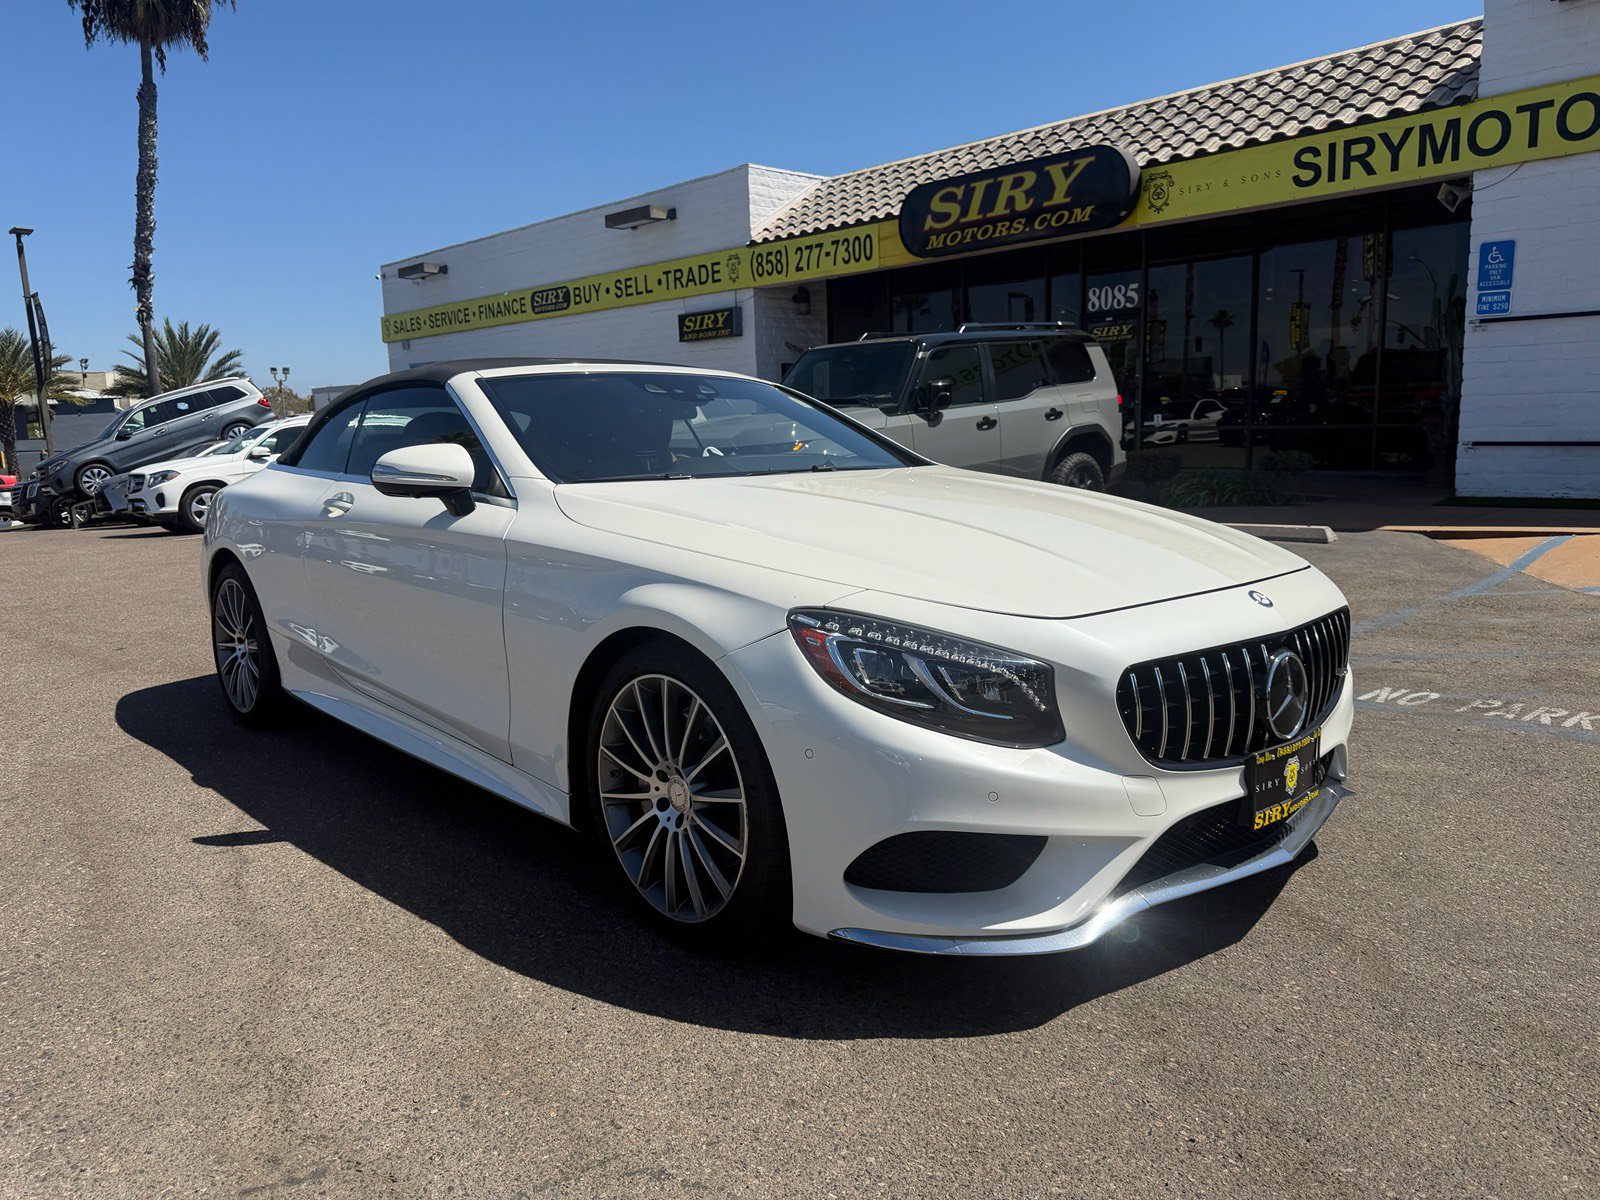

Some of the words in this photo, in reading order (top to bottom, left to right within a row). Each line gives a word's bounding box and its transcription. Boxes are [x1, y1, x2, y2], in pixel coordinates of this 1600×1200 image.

[1291, 91, 1600, 188] SIRYMOTO
[923, 155, 1097, 232] SIRY
[1178, 182, 1212, 196] SIRY
[1222, 179, 1230, 188] &
[1240, 169, 1282, 185] SONS
[925, 205, 1095, 250] MOTORS.COM
[750, 243, 789, 282] (858)
[794, 233, 874, 274] 277-7300
[1484, 262, 1508, 270] PARKING
[573, 282, 602, 305] BUY
[614, 275, 653, 298] SELL
[663, 261, 722, 290] TRADE
[1480, 279, 1510, 287] ACCESSIBLE
[534, 288, 568, 306] SIRY
[1087, 283, 1139, 312] 8085
[1477, 303, 1490, 311] FINE
[1492, 302, 1509, 310] $250
[1482, 294, 1507, 302] MINIMUM
[393, 316, 422, 335] SALES
[428, 308, 470, 329] SERVICE
[478, 297, 527, 320] FINANCE
[683, 311, 730, 332] SIRY
[1092, 324, 1133, 338] SIRY
[1357, 687, 1440, 706] NO
[1255, 778, 1280, 793] SIRY
[1253, 801, 1292, 830] SIRY
